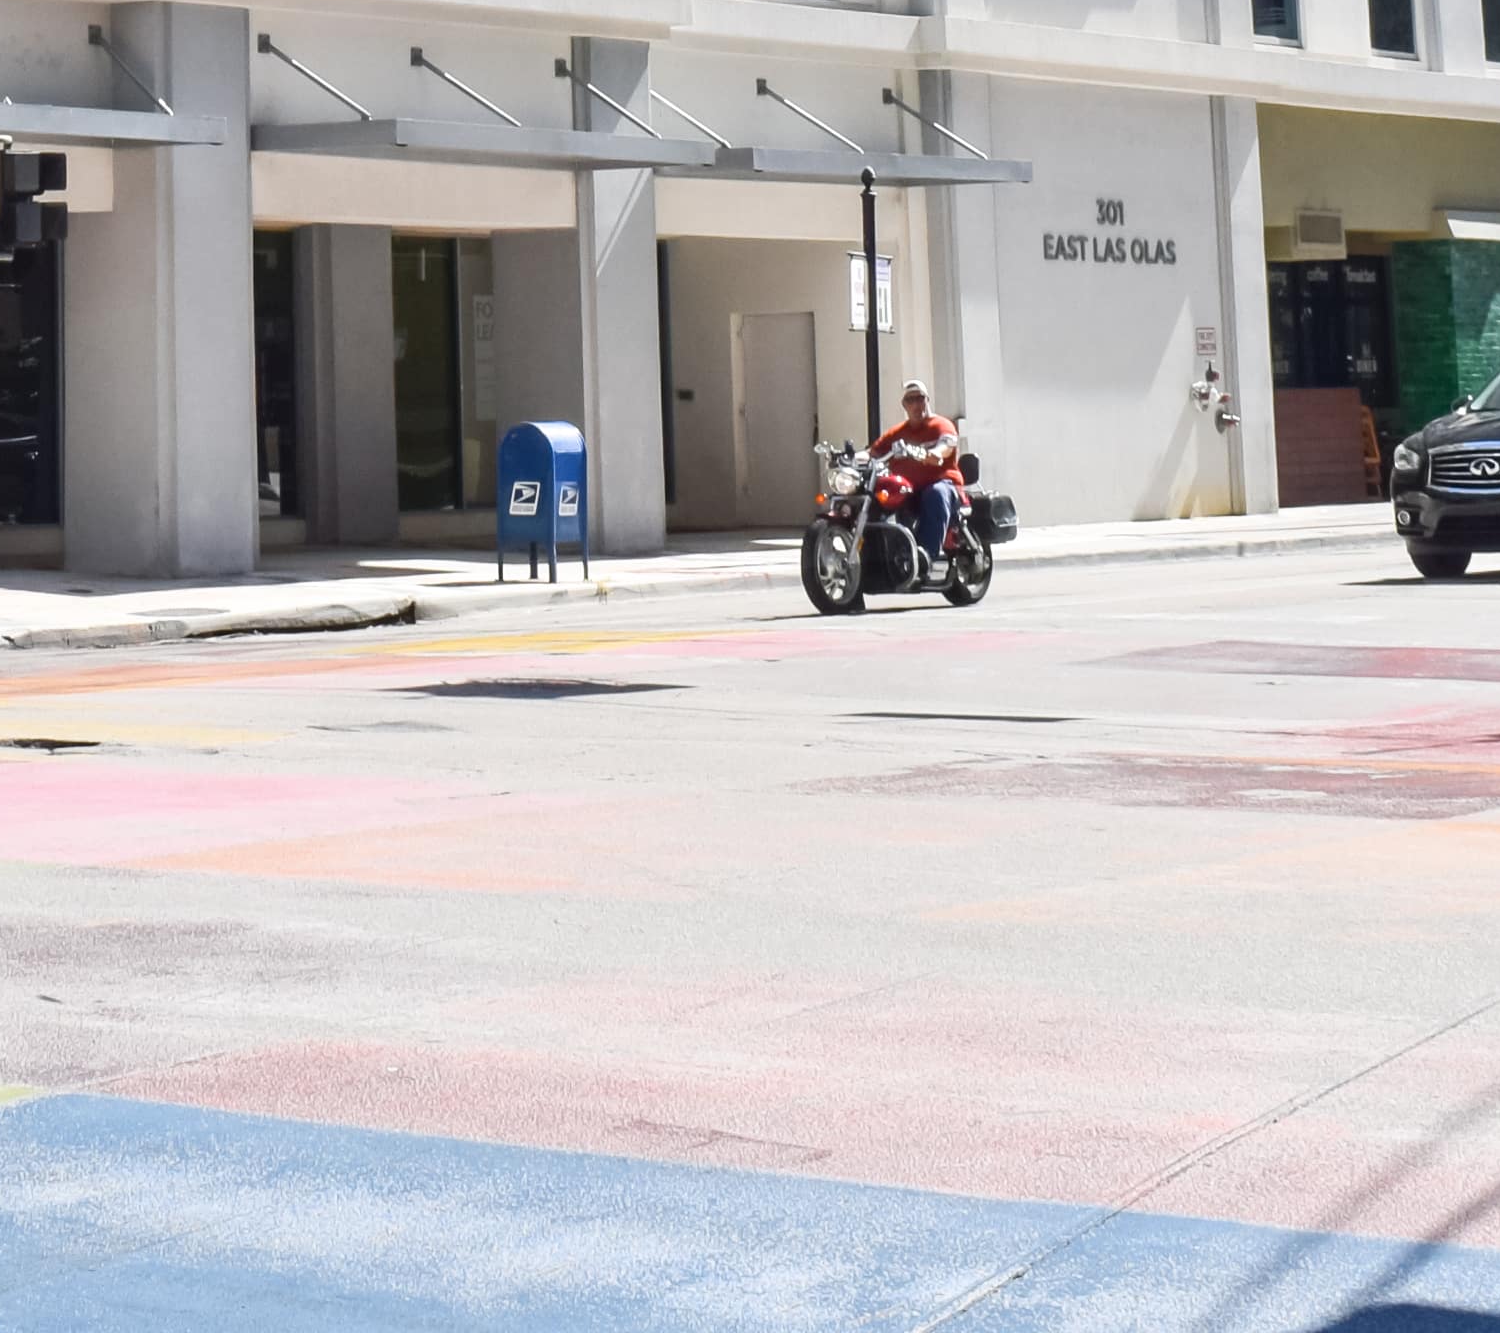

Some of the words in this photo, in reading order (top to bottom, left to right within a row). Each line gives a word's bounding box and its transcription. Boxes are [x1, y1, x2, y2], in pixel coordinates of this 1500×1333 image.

[1096, 199, 1124, 225] 301
[1043, 234, 1088, 261] EAST
[1093, 237, 1126, 263] LAS
[1130, 238, 1176, 265] OLAS
